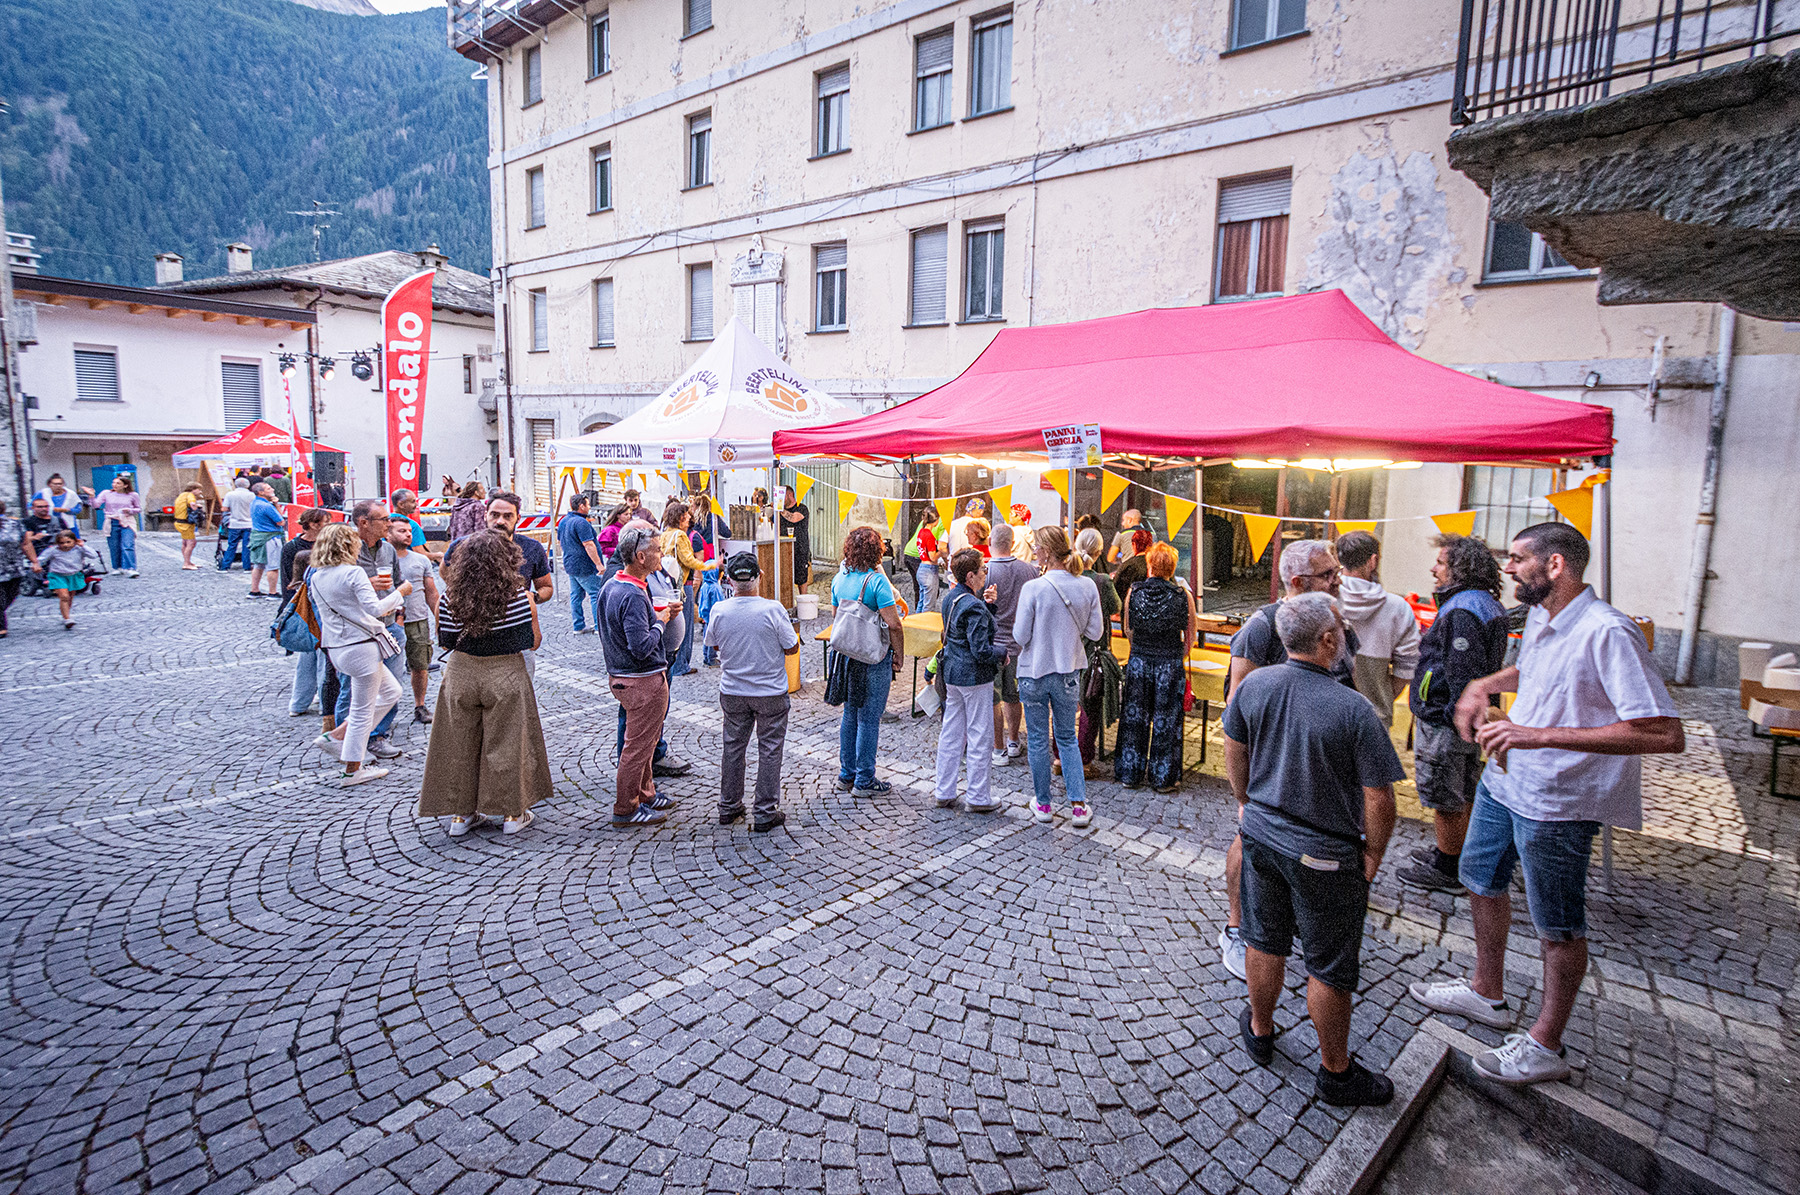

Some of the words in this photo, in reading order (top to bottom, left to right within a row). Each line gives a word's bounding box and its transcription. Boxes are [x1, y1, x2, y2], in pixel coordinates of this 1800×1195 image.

[669, 370, 719, 398] BEERTELLINA
[745, 367, 809, 395] BEERTELLINA
[1044, 427, 1076, 439] PANINI
[1046, 436, 1083, 447] GRIGLIA
[595, 444, 643, 458] BEERTELLINA
